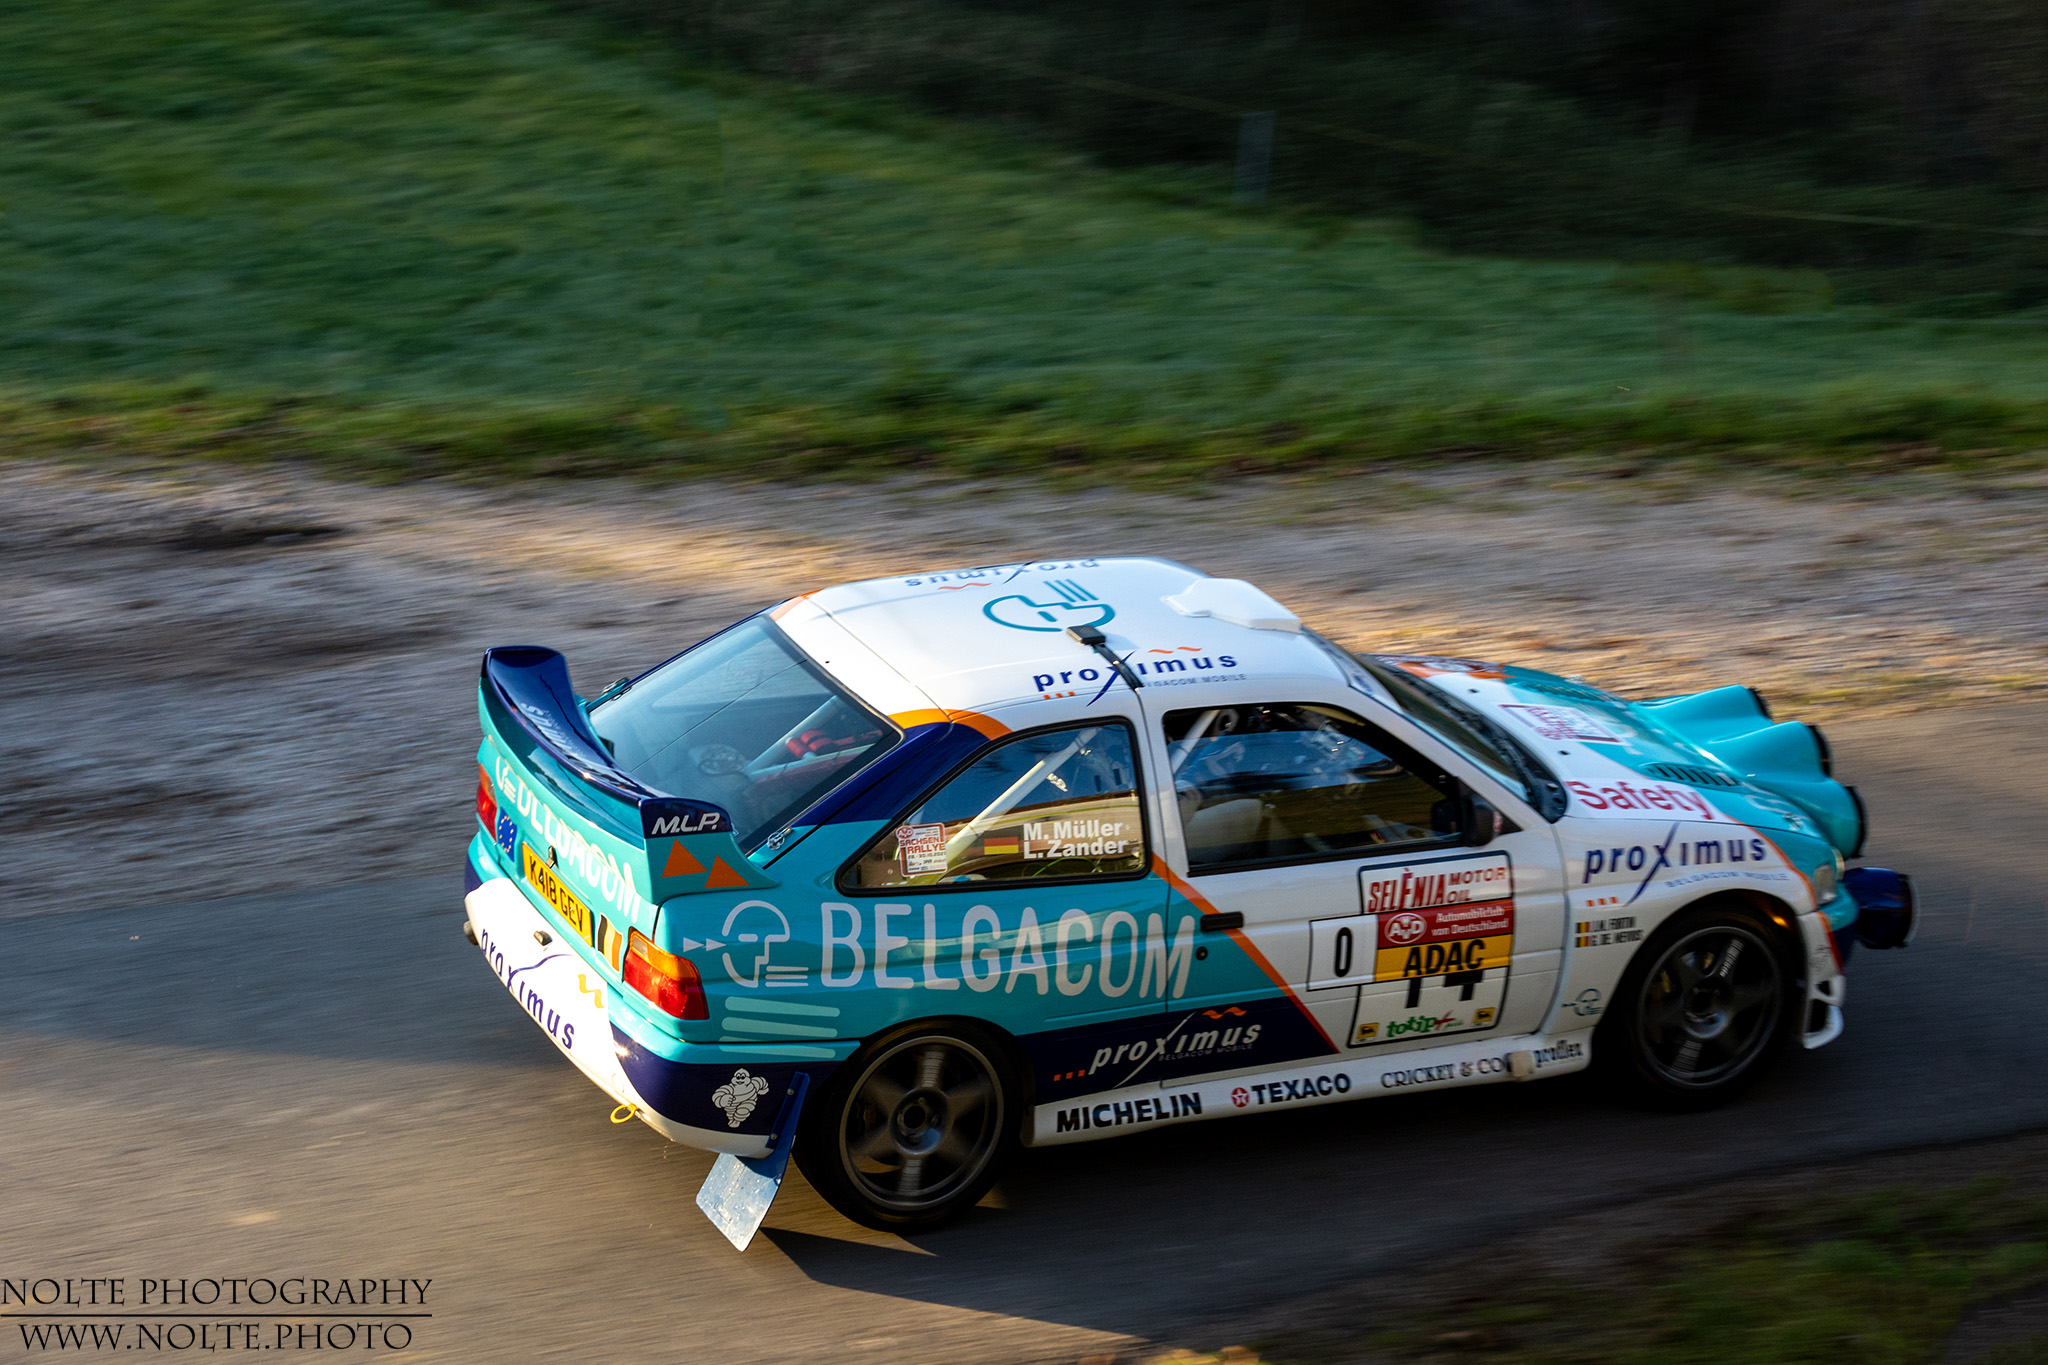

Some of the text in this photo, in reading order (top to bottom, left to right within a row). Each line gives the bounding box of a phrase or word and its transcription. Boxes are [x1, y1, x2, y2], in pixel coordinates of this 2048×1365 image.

[1565, 780, 1715, 820] Safety
[651, 812, 721, 835] M.L.P.
[1023, 819, 1124, 841] M. Müller
[900, 837, 939, 847] SACHSEN
[907, 843, 946, 854] RALLYE
[1023, 837, 1126, 860] L. Zander
[1448, 867, 1507, 885] MOTOR
[1447, 889, 1471, 903] OIL
[1436, 906, 1505, 923] Automobilclub
[1431, 918, 1508, 936] von Deutschland
[821, 901, 1195, 999] BELGACOM
[1334, 927, 1353, 977] 0
[1402, 938, 1486, 977] ADAC
[1158, 1048, 1213, 1061] BELGACOM
[1381, 1063, 1456, 1089] CRICKET
[1459, 1062, 1473, 1077] &
[1252, 1073, 1351, 1105] TEXACO
[1057, 1092, 1202, 1133] MICHELIN
